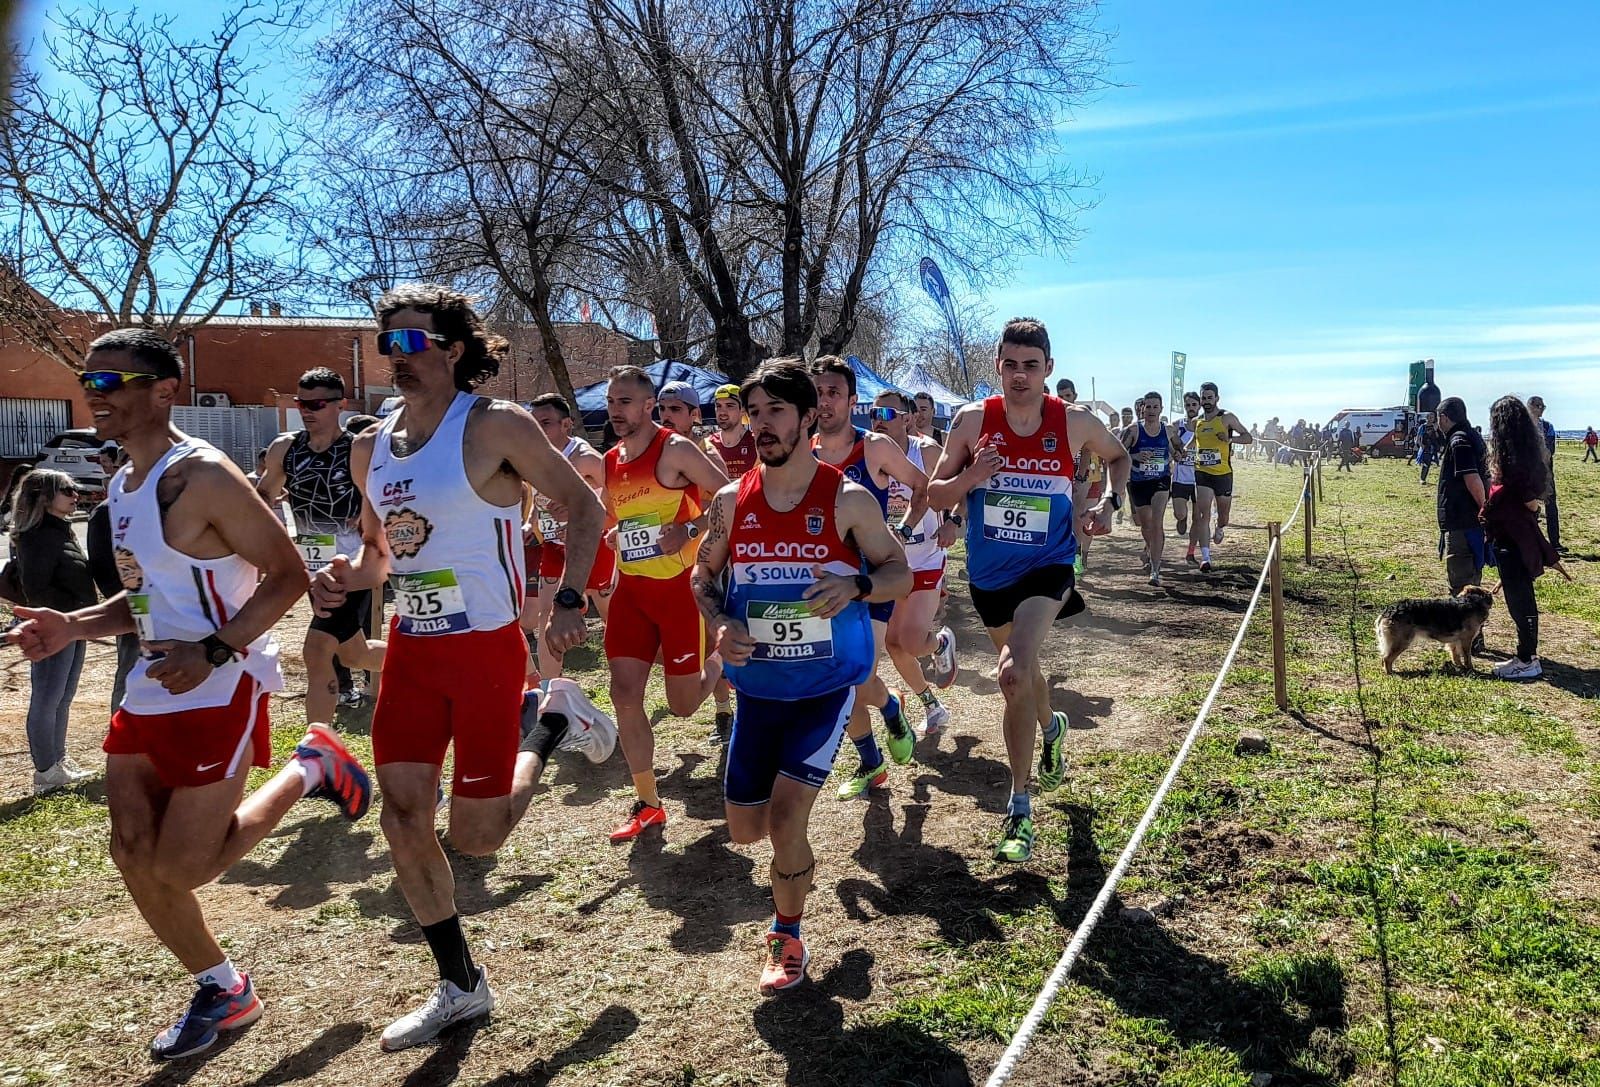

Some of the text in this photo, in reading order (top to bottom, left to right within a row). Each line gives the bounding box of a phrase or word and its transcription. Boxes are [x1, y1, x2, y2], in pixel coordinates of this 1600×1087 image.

[998, 456, 1061, 472] OLANCO
[383, 479, 413, 496] CAT
[1003, 476, 1052, 490] SOLVAY
[1003, 510, 1027, 528] 96
[624, 530, 650, 547] 169
[994, 528, 1033, 542] Joma
[306, 547, 322, 560] 12
[626, 547, 656, 560] Joma
[735, 542, 829, 559] POLANCO
[404, 591, 443, 616] 325
[773, 621, 804, 642] 95
[767, 644, 816, 658] Joma
